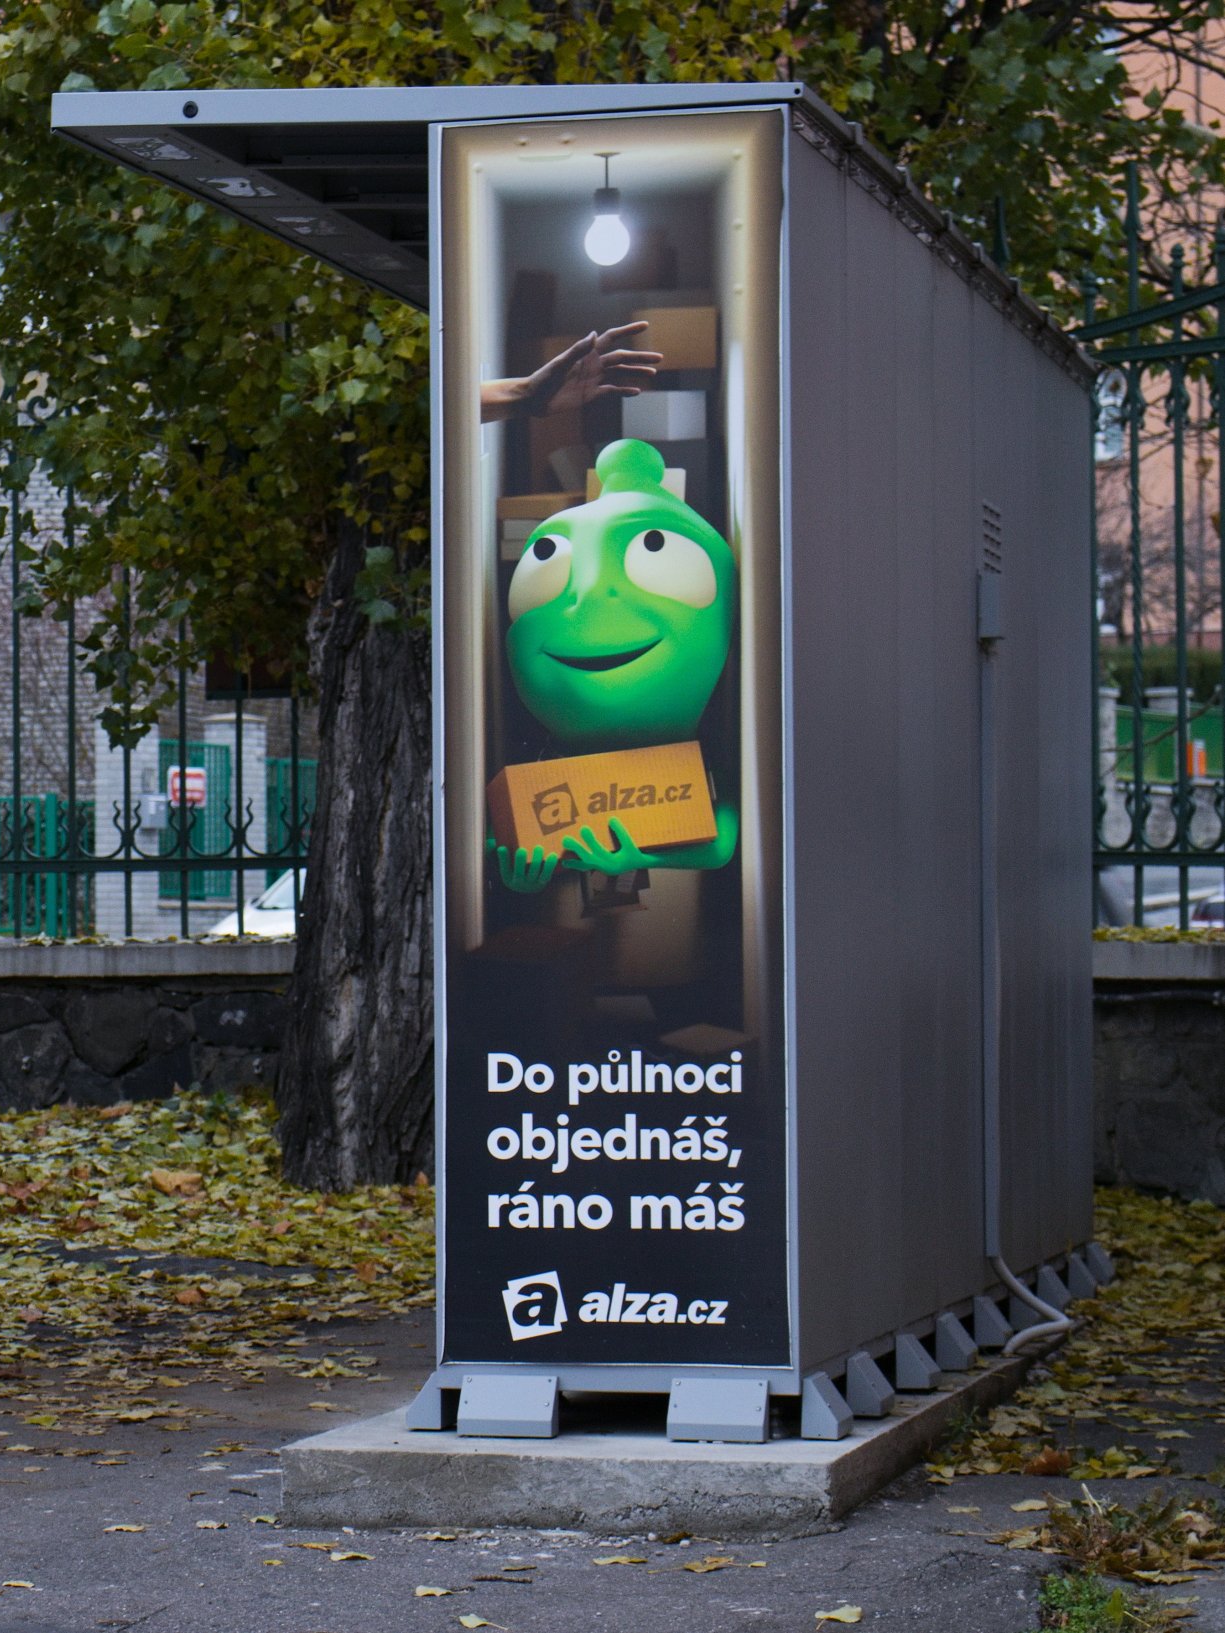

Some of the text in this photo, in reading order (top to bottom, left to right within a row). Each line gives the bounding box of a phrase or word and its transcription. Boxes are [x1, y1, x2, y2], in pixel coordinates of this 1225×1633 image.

[587, 782, 693, 815] alza.cz
[487, 1049, 743, 1106] Do půlnoci
[487, 1112, 743, 1174] objednáš,
[487, 1180, 746, 1232] ráno máš
[578, 1282, 729, 1325] alza.cz
